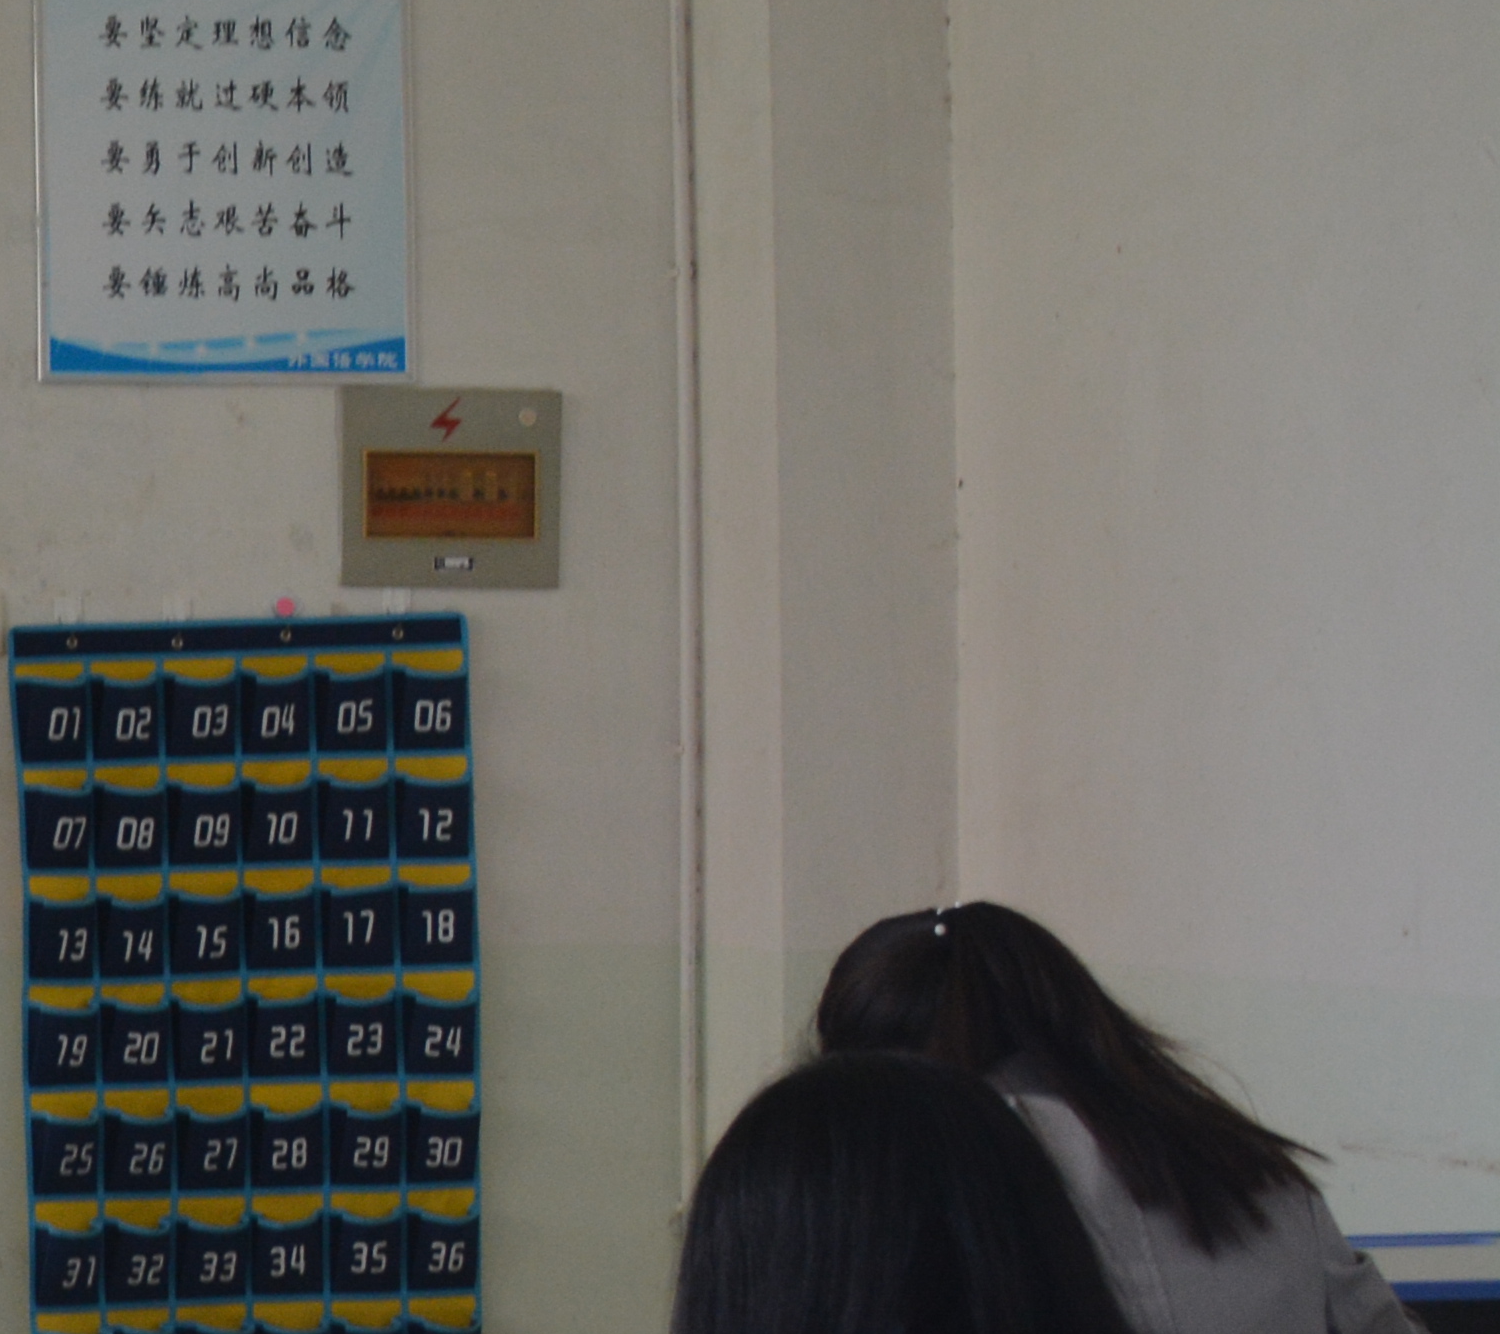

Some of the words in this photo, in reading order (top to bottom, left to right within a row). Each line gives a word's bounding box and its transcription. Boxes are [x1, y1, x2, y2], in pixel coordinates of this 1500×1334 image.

[98, 15, 352, 52] 要坚定理想信念
[100, 76, 350, 113] 要练就过硬本领
[101, 140, 354, 177] 要勇于创新创造
[102, 200, 351, 240] 要矢志艰苦奋斗
[103, 264, 356, 300] 要锤炼高尚品格
[49, 708, 80, 740] 01
[116, 707, 151, 739] 02
[193, 705, 228, 737] 03
[261, 705, 294, 737] 04
[338, 700, 372, 732] 05
[415, 700, 451, 731] 06
[53, 817, 86, 848] 07
[117, 817, 154, 849] 08
[194, 814, 229, 846] 09
[268, 812, 297, 843] 10
[343, 810, 372, 840] 11
[420, 809, 452, 840] 12
[59, 929, 87, 960] 13
[124, 931, 152, 961] 14
[198, 926, 226, 957] 15
[269, 916, 299, 948] 16
[345, 910, 374, 943] 17
[423, 910, 454, 942] 18
[58, 1035, 87, 1066] 19
[124, 1032, 159, 1063] 20
[201, 1030, 233, 1063] 21
[270, 1025, 305, 1057] 22
[347, 1023, 382, 1055] 23
[425, 1026, 461, 1056] 24
[60, 1144, 93, 1175] 25
[130, 1143, 165, 1173] 26
[204, 1138, 237, 1170] 27
[272, 1138, 307, 1169] 28
[354, 1137, 389, 1167] 29
[426, 1137, 462, 1166] 30
[63, 1257, 95, 1287] 31
[128, 1254, 164, 1284] 32
[201, 1252, 236, 1281] 33
[271, 1245, 305, 1276] 34
[351, 1242, 386, 1273] 35
[429, 1241, 464, 1271] 36
